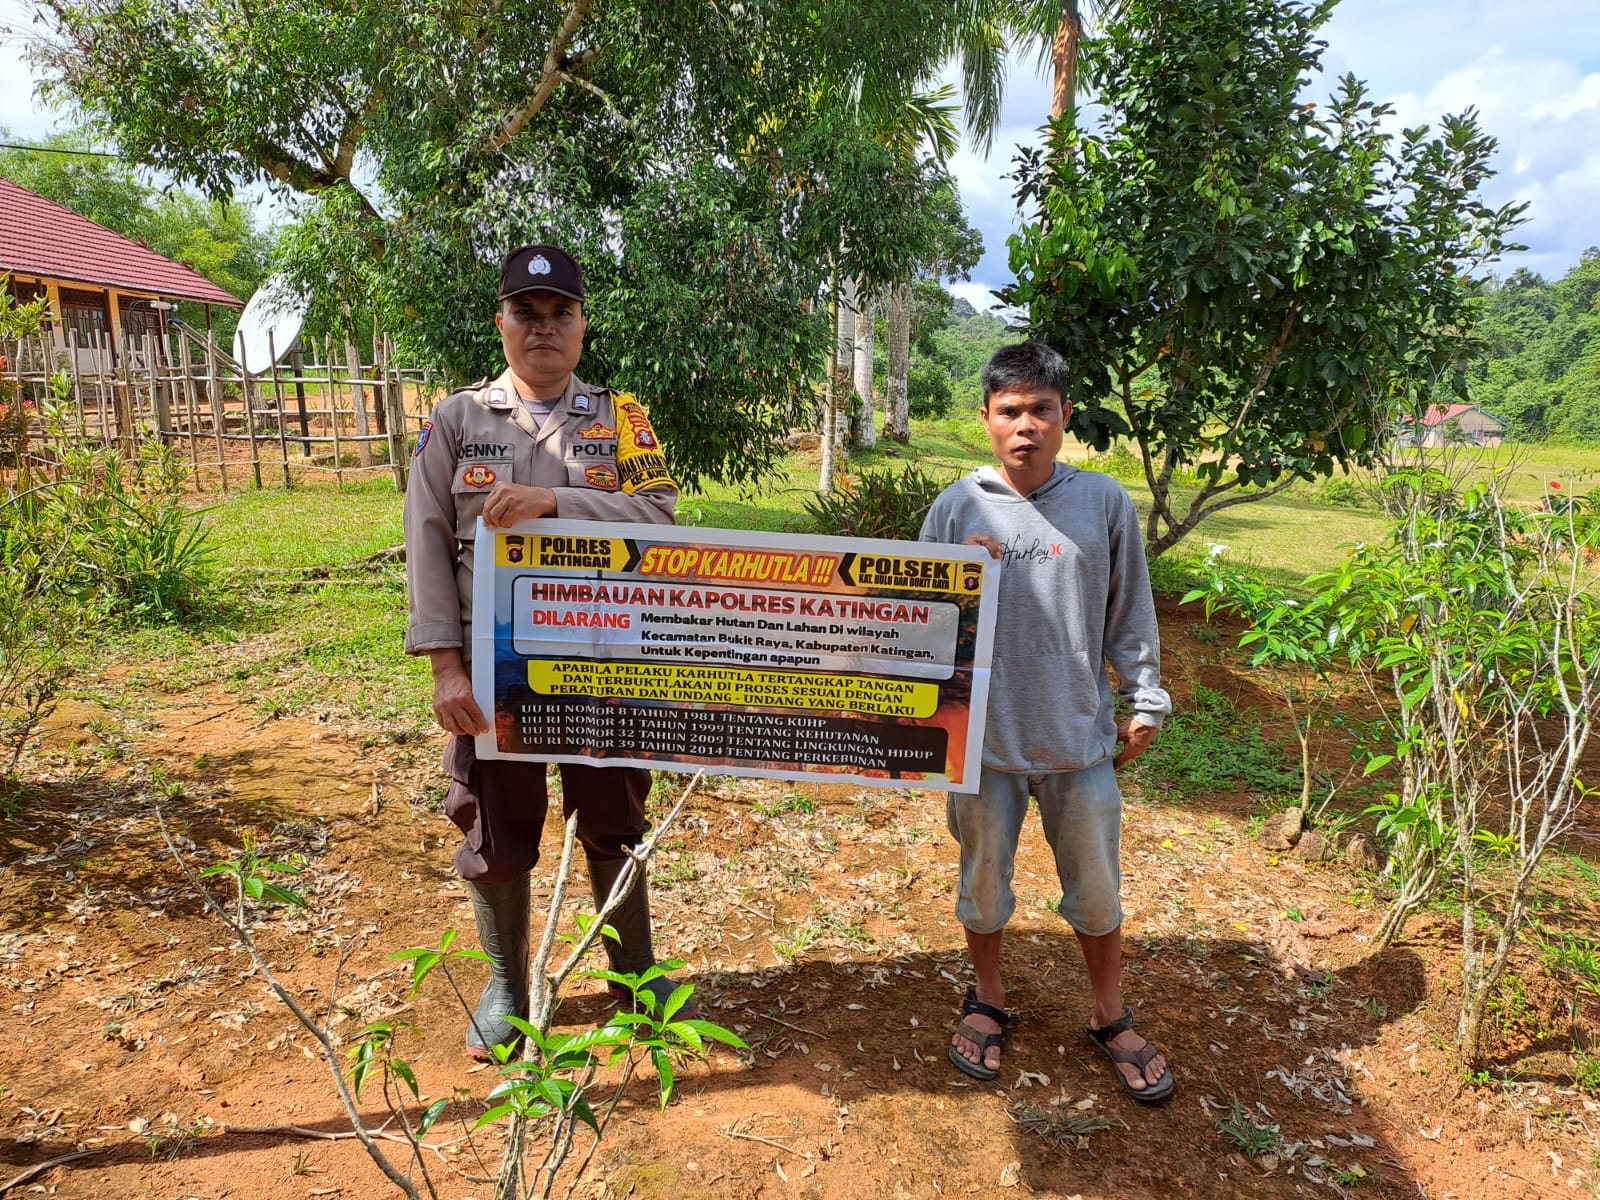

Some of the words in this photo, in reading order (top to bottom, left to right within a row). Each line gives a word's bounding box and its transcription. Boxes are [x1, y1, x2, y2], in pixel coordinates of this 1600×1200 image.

[573, 443, 617, 457] POLR
[540, 536, 611, 555] POLRES
[1000, 533, 1053, 568] Hurley
[540, 554, 611, 569] KATINGAN
[640, 547, 699, 574] STOP
[859, 556, 950, 579] POLSEK
[531, 582, 665, 607] HIMBAUAN
[669, 589, 795, 615] KAPOLRES
[799, 598, 929, 624] KATINGAN
[532, 610, 631, 629] DILARANG
[640, 613, 713, 625] Membakar
[715, 616, 755, 629] Hutan
[757, 619, 784, 631] Dan
[786, 621, 827, 634] Lahan
[829, 624, 843, 635] Di
[846, 626, 900, 640] wilayah
[641, 630, 716, 643] Kecamatan
[718, 633, 753, 646] Bukit
[755, 637, 793, 649] Raya,
[795, 640, 868, 653] Kabupaten
[870, 644, 935, 660] Katingan,
[641, 646, 681, 656] Untuk
[684, 647, 767, 663] Kepentingan
[769, 655, 820, 666] apapun
[552, 663, 612, 674] APABILA
[615, 666, 672, 677] PELAKU
[676, 668, 754, 682] KARHUTLA
[758, 674, 854, 688] TERTANGKAP
[856, 679, 915, 694] TANGAN
[563, 674, 593, 684] DAN
[717, 682, 732, 691] DI
[735, 683, 789, 695] PROSES
[791, 687, 841, 698] SESUAI
[845, 690, 903, 704] DENGAN
[550, 684, 635, 696] PERATURAN
[638, 688, 669, 698] DAN
[673, 690, 732, 702] UNDANG
[743, 694, 804, 707] UNDANG
[807, 698, 845, 709] YANG
[849, 701, 915, 716] BERLAKU
[521, 704, 542, 713] UU
[546, 704, 561, 713] RI
[564, 704, 615, 716] NOMOR
[618, 707, 627, 715] 8
[630, 708, 678, 719] TAHUN
[683, 711, 716, 721] 1981
[720, 713, 784, 726] TENTANG
[787, 717, 827, 728] KUHP
[522, 716, 542, 724] UU
[546, 716, 561, 724] RI
[565, 715, 615, 727] NOMOR
[618, 718, 634, 727] 41
[638, 719, 687, 731] TAHUN
[691, 723, 725, 732] 1999
[727, 724, 792, 737] TENTANG
[795, 729, 880, 745] KEHUTANAN
[522, 726, 542, 735] UU
[547, 726, 561, 735] RI
[565, 726, 615, 738] NOMOR
[618, 729, 635, 738] 32
[638, 730, 686, 742] TAHUN
[689, 733, 724, 744] 2009
[726, 735, 791, 749] TENTANG
[794, 741, 884, 756] LINGKUNGAN
[888, 748, 934, 760] HIDUP
[523, 737, 543, 745] UU
[547, 737, 561, 745] RI
[565, 737, 615, 749] NOMOR
[618, 740, 635, 748] 39
[638, 741, 686, 752] TAHUN
[689, 745, 723, 755] 2014
[726, 747, 791, 760] TENTANG
[794, 752, 887, 768] PERKEBUNAN
